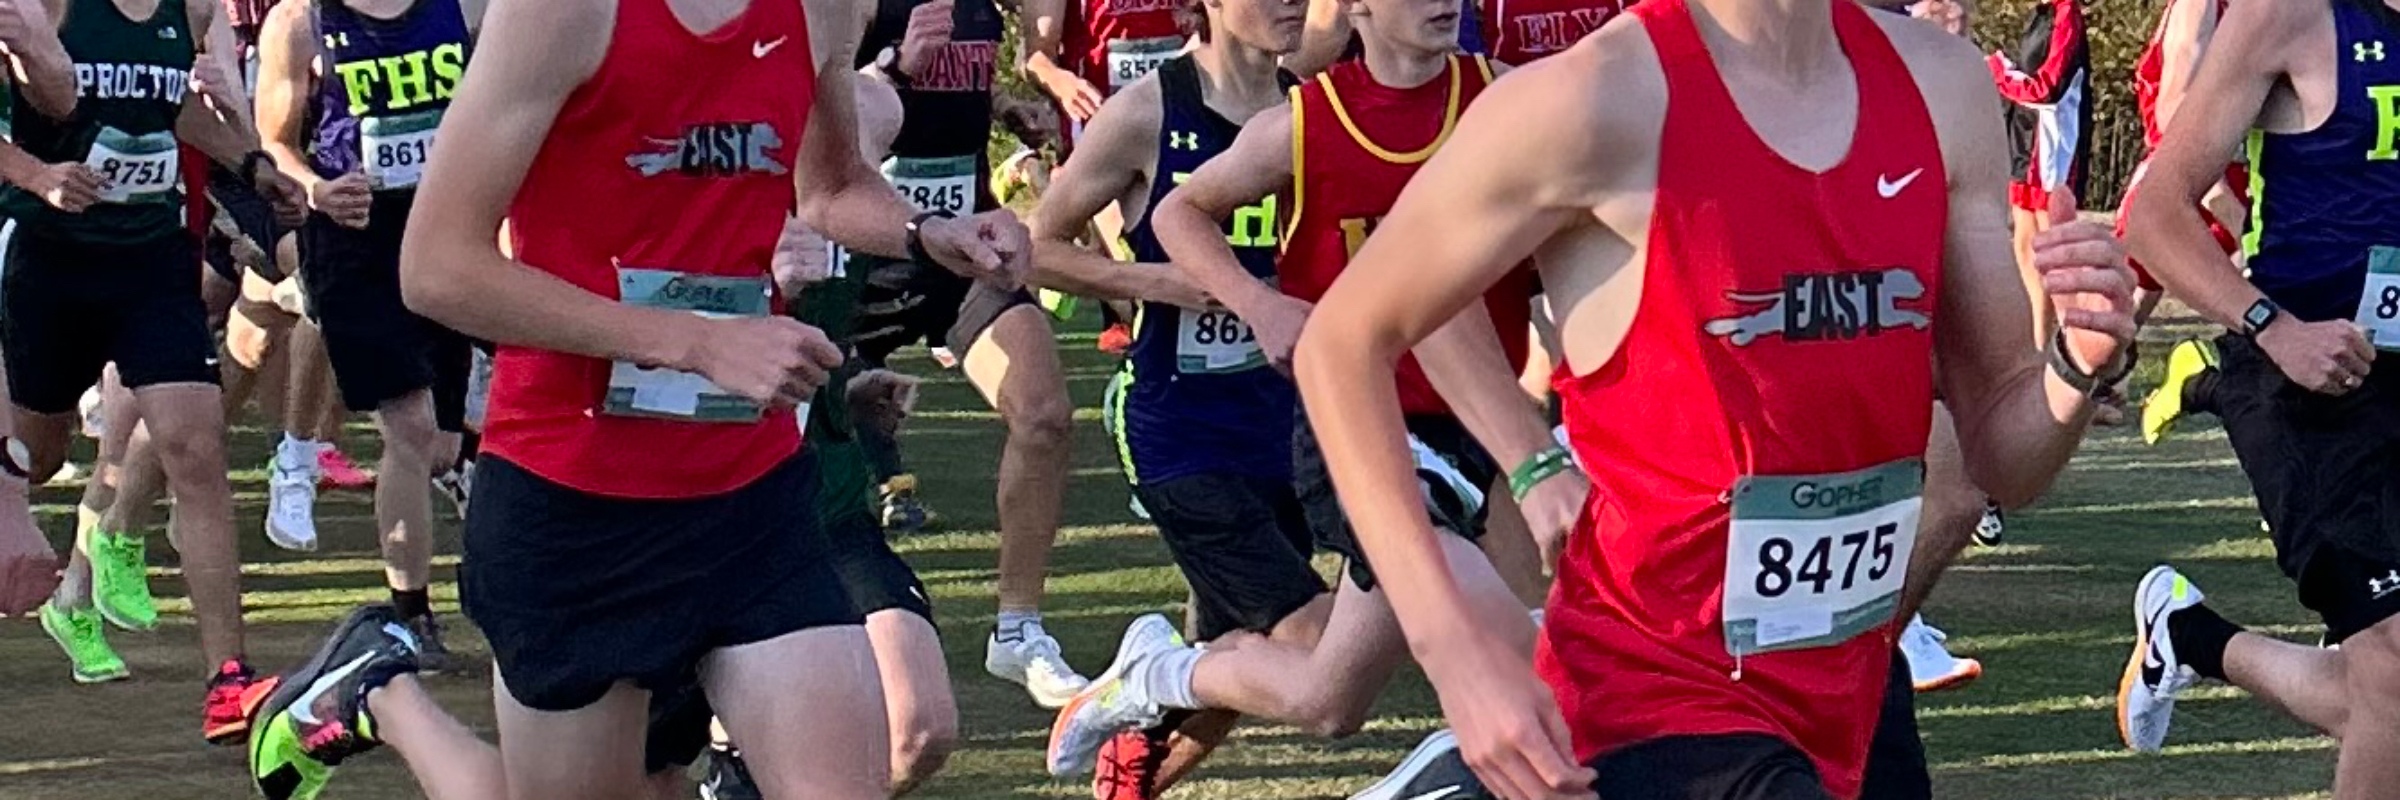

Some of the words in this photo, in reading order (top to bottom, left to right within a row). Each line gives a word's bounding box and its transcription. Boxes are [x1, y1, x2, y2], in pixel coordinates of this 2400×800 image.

[334, 42, 464, 116] FHS
[911, 40, 995, 91] ANT
[377, 135, 435, 167] 861
[680, 122, 752, 176] EAST
[1783, 271, 1883, 340] EAST
[1755, 522, 1898, 597] 8475
